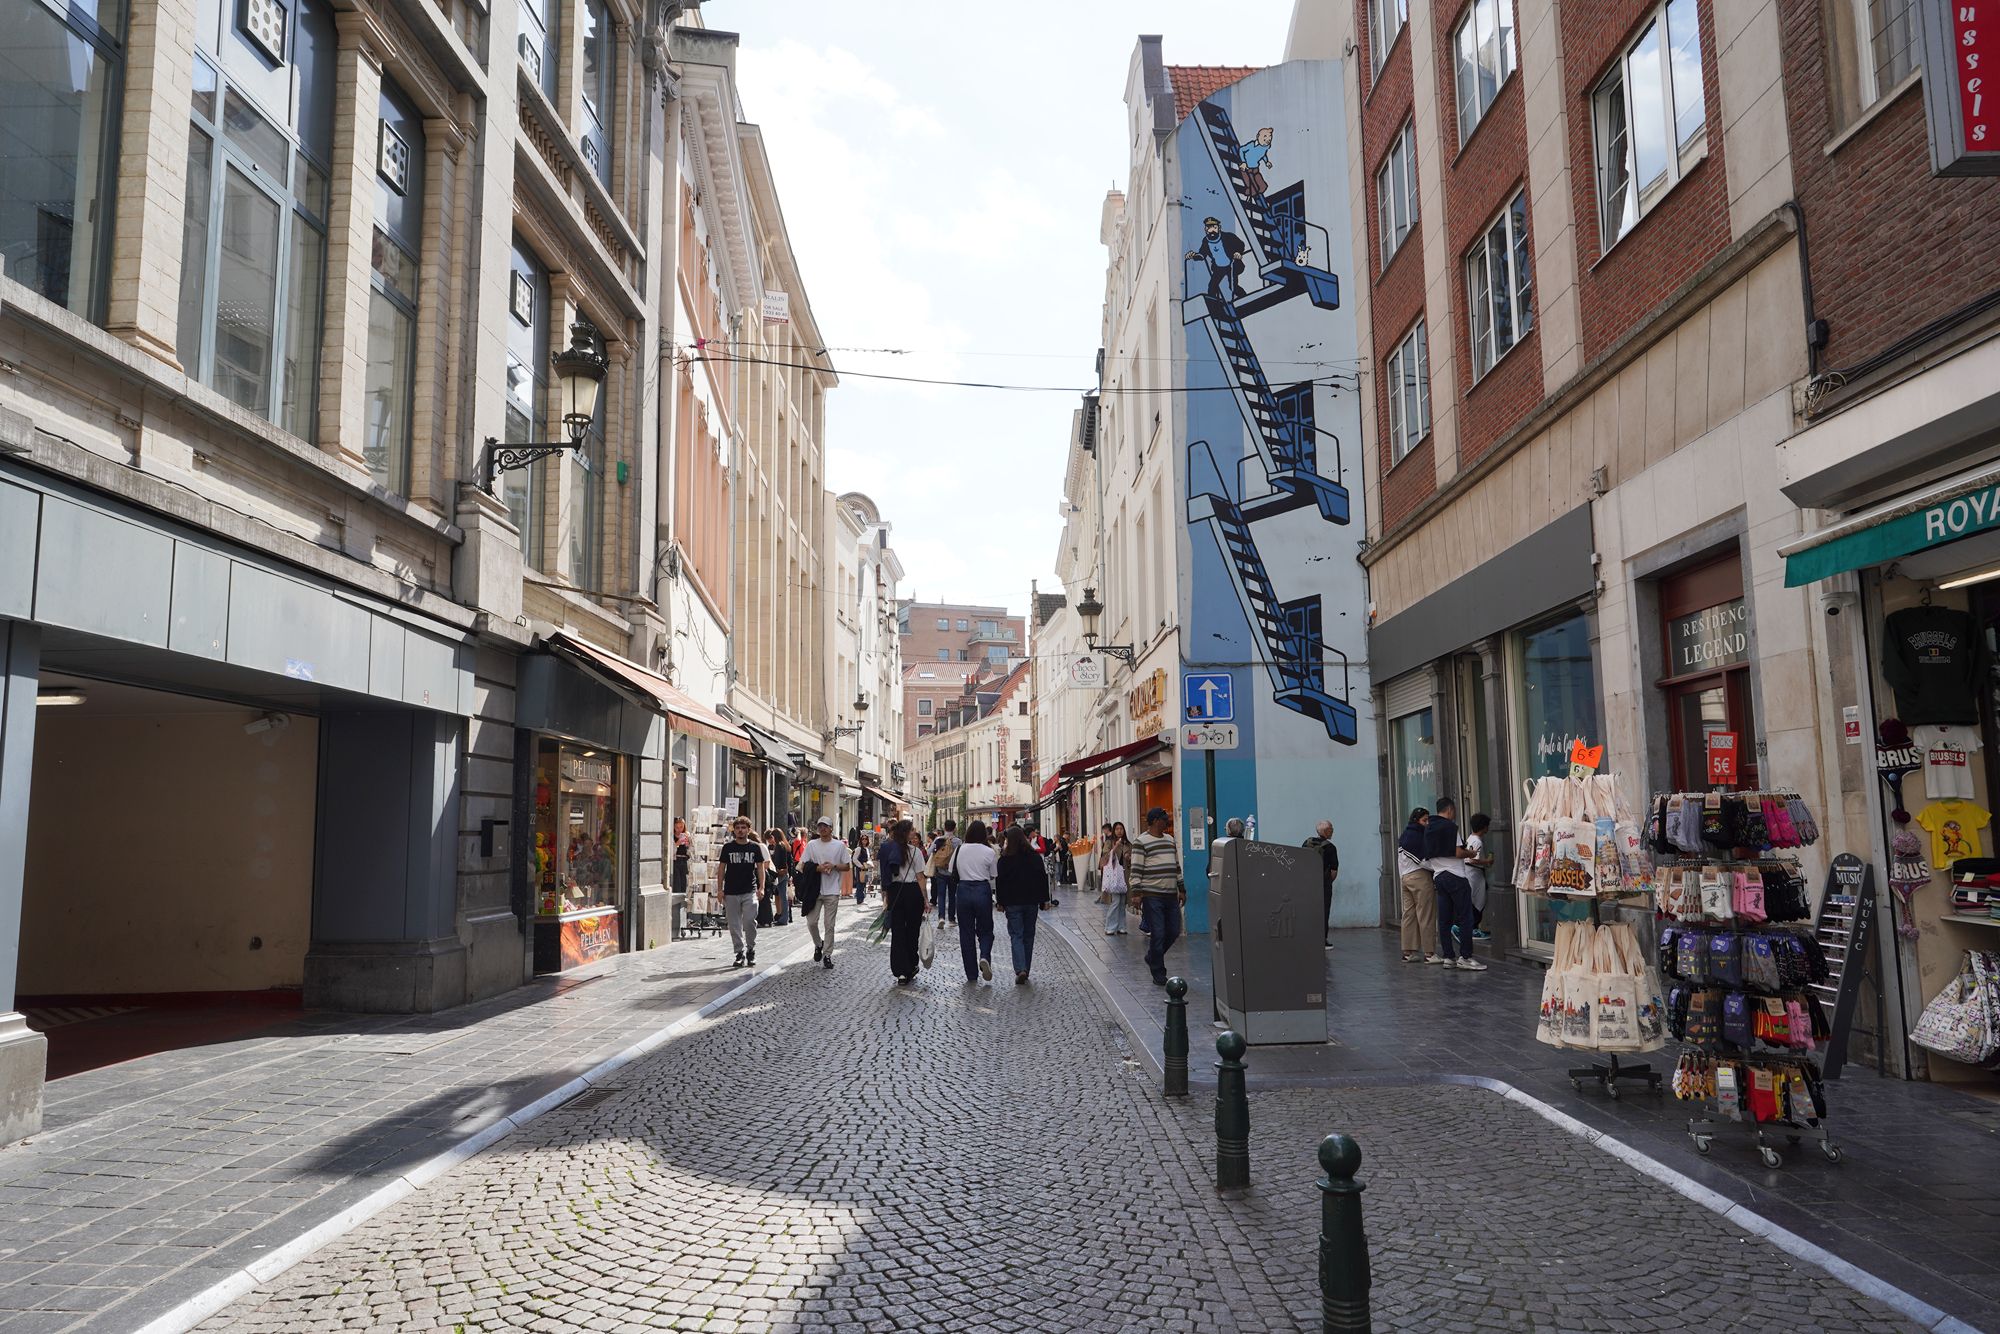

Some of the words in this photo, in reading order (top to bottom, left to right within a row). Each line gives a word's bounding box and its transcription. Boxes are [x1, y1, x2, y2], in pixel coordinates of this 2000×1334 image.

[1959, 7, 1986, 141] ussels
[1682, 605, 1746, 637] RESIDENC
[1683, 631, 1749, 666] LEGEND
[1907, 630, 1958, 650] BRUSSELS
[1711, 735, 1733, 748] SOCKS
[1713, 757, 1730, 773] 5€
[1877, 747, 1921, 768] BRUS
[1930, 752, 1965, 762] BRUSSELS
[573, 759, 612, 782] PELICAEN
[1836, 872, 1862, 885] MUSIC
[1893, 861, 1930, 880] BRUS
[1854, 898, 1873, 951] MUSIC
[580, 927, 612, 948] PELICAEN
